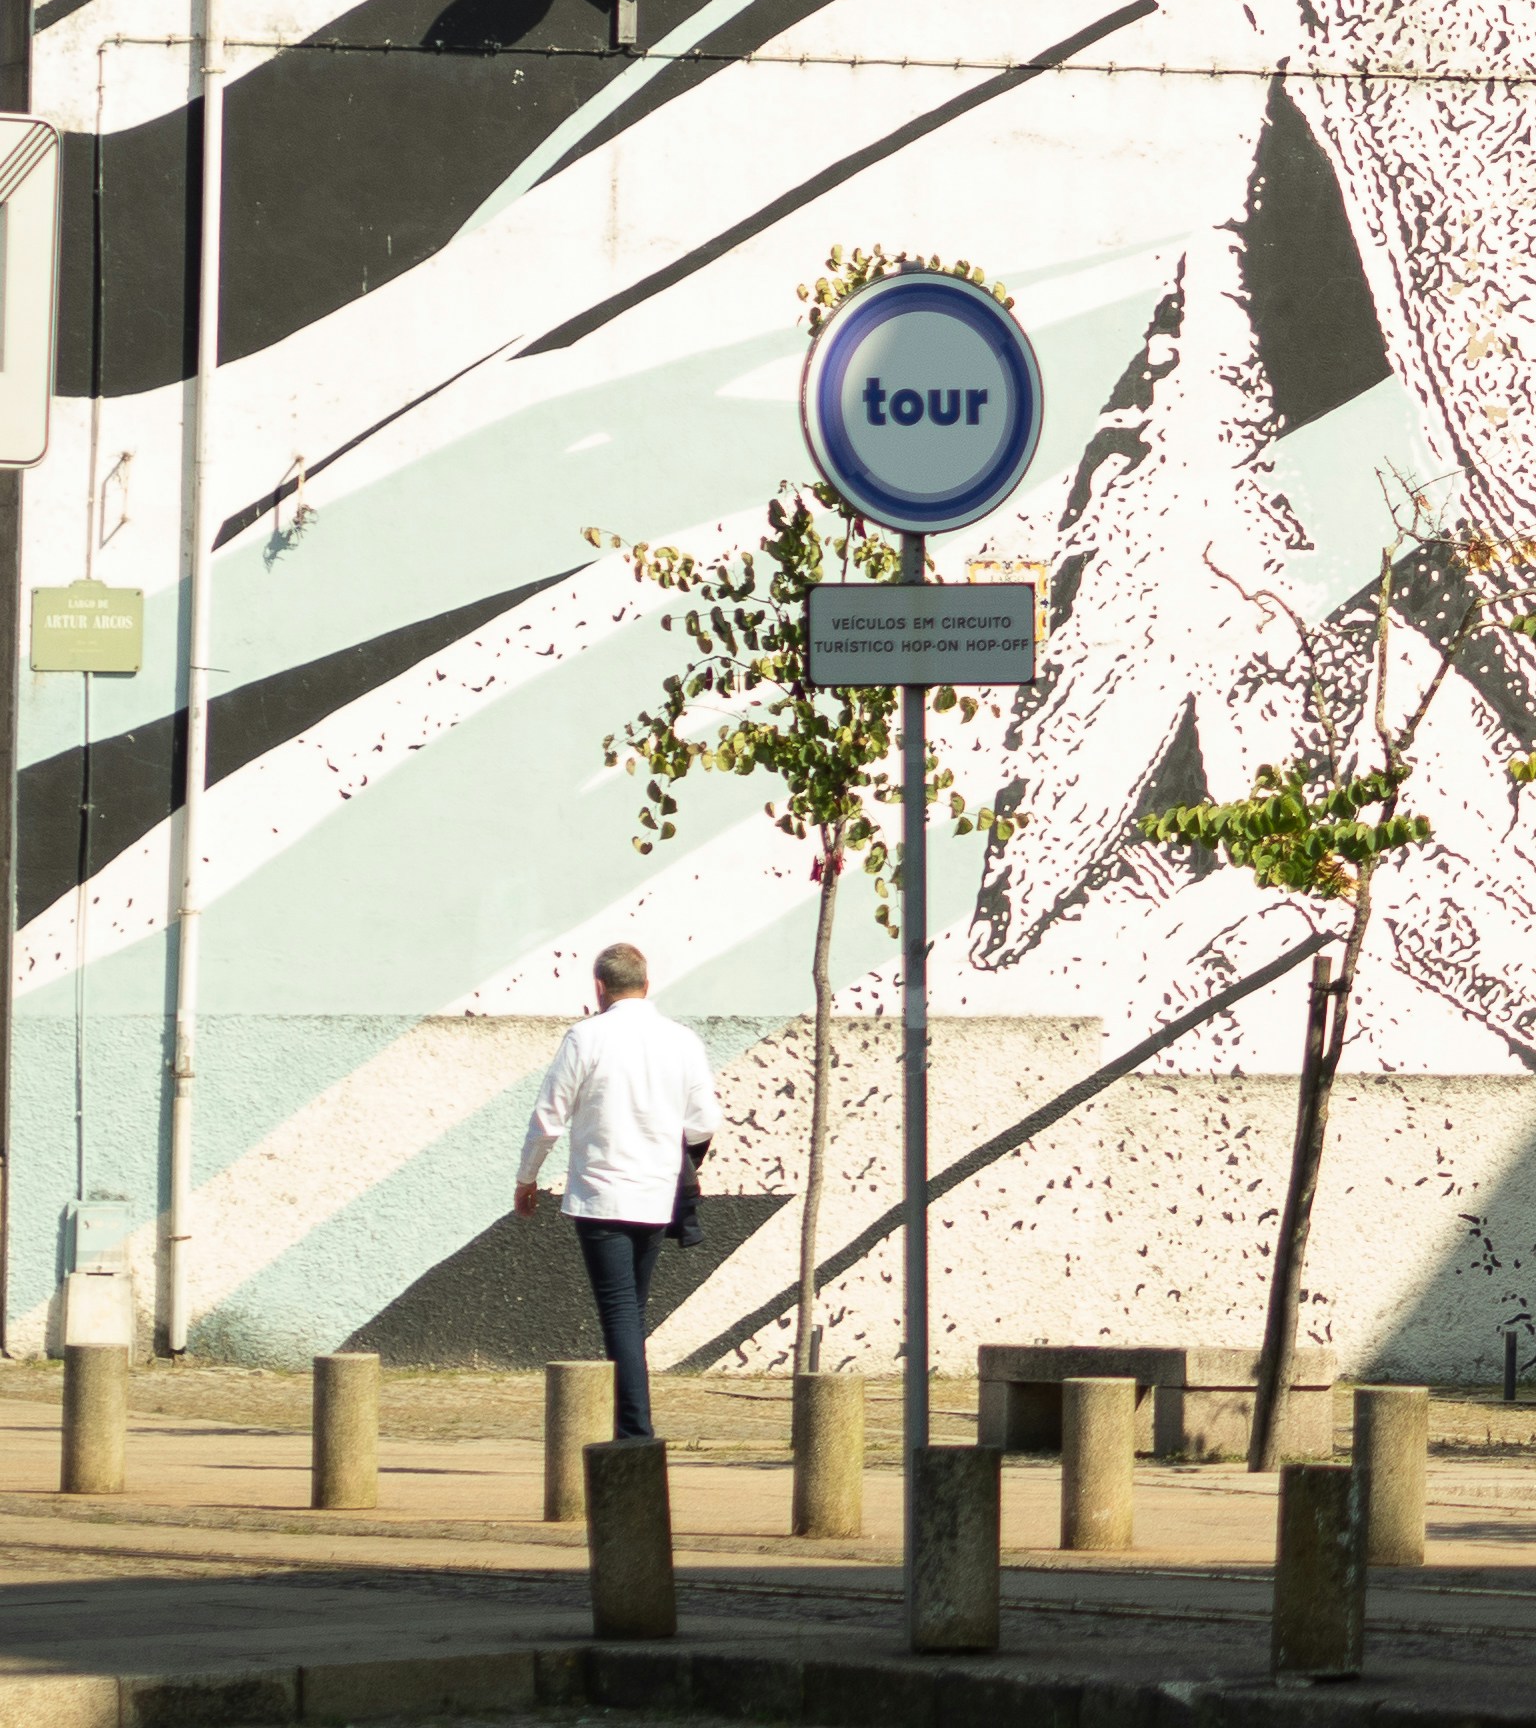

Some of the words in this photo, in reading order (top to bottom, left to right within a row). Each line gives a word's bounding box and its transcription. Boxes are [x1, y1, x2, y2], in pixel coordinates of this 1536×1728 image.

[862, 377, 988, 426] tour
[67, 599, 96, 609] LARGO
[97, 599, 109, 609] DE
[44, 615, 87, 629] ARTUR
[92, 615, 133, 629] ARCOS
[832, 615, 906, 630] VEÍCULOS
[913, 617, 935, 630] EM
[941, 616, 1012, 630] CIRCUITO
[814, 638, 894, 653] TURÍSTICO
[901, 639, 959, 652] HOP-ON
[966, 638, 1029, 651] HOP-OFF
